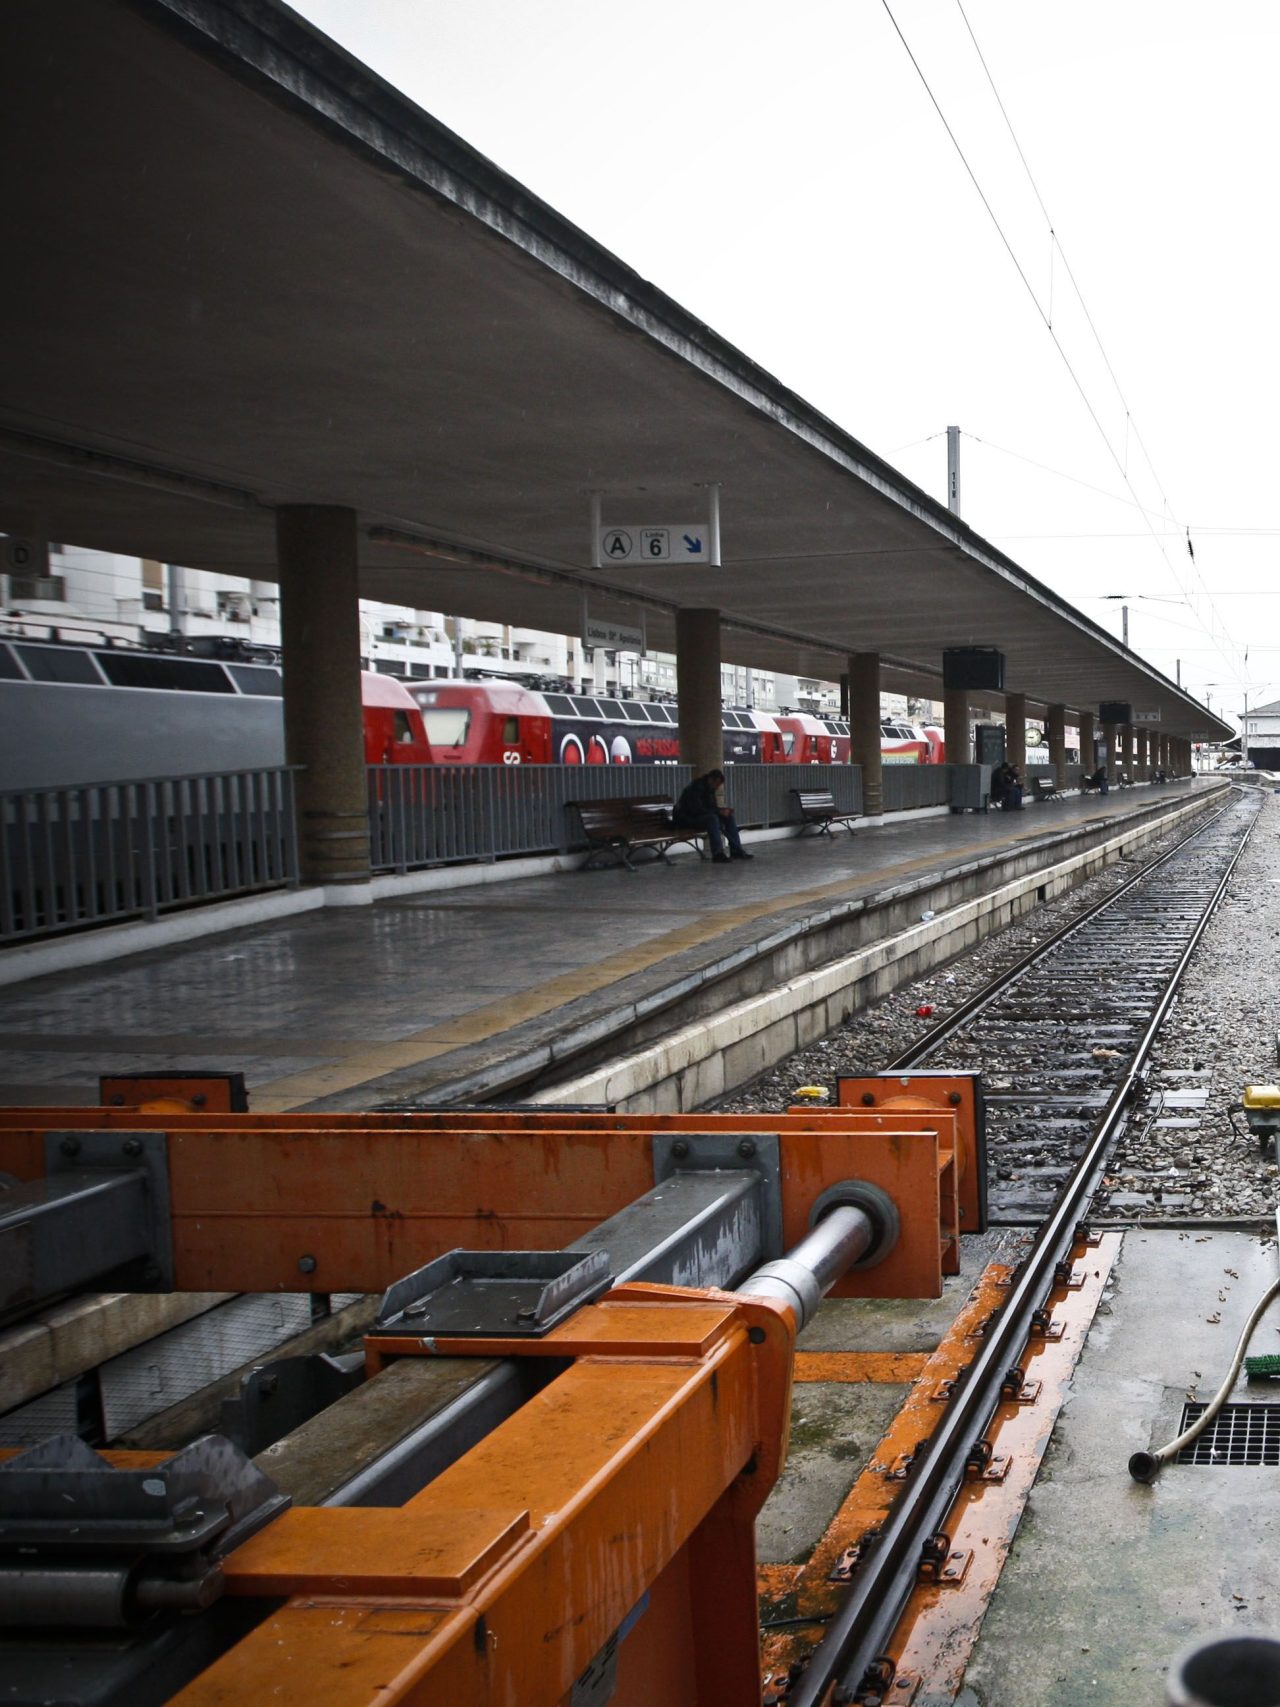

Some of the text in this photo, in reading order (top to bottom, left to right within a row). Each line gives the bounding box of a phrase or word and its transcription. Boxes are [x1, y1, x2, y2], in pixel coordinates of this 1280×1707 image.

[610, 536, 662, 556] A 6
[15, 547, 29, 564] D
